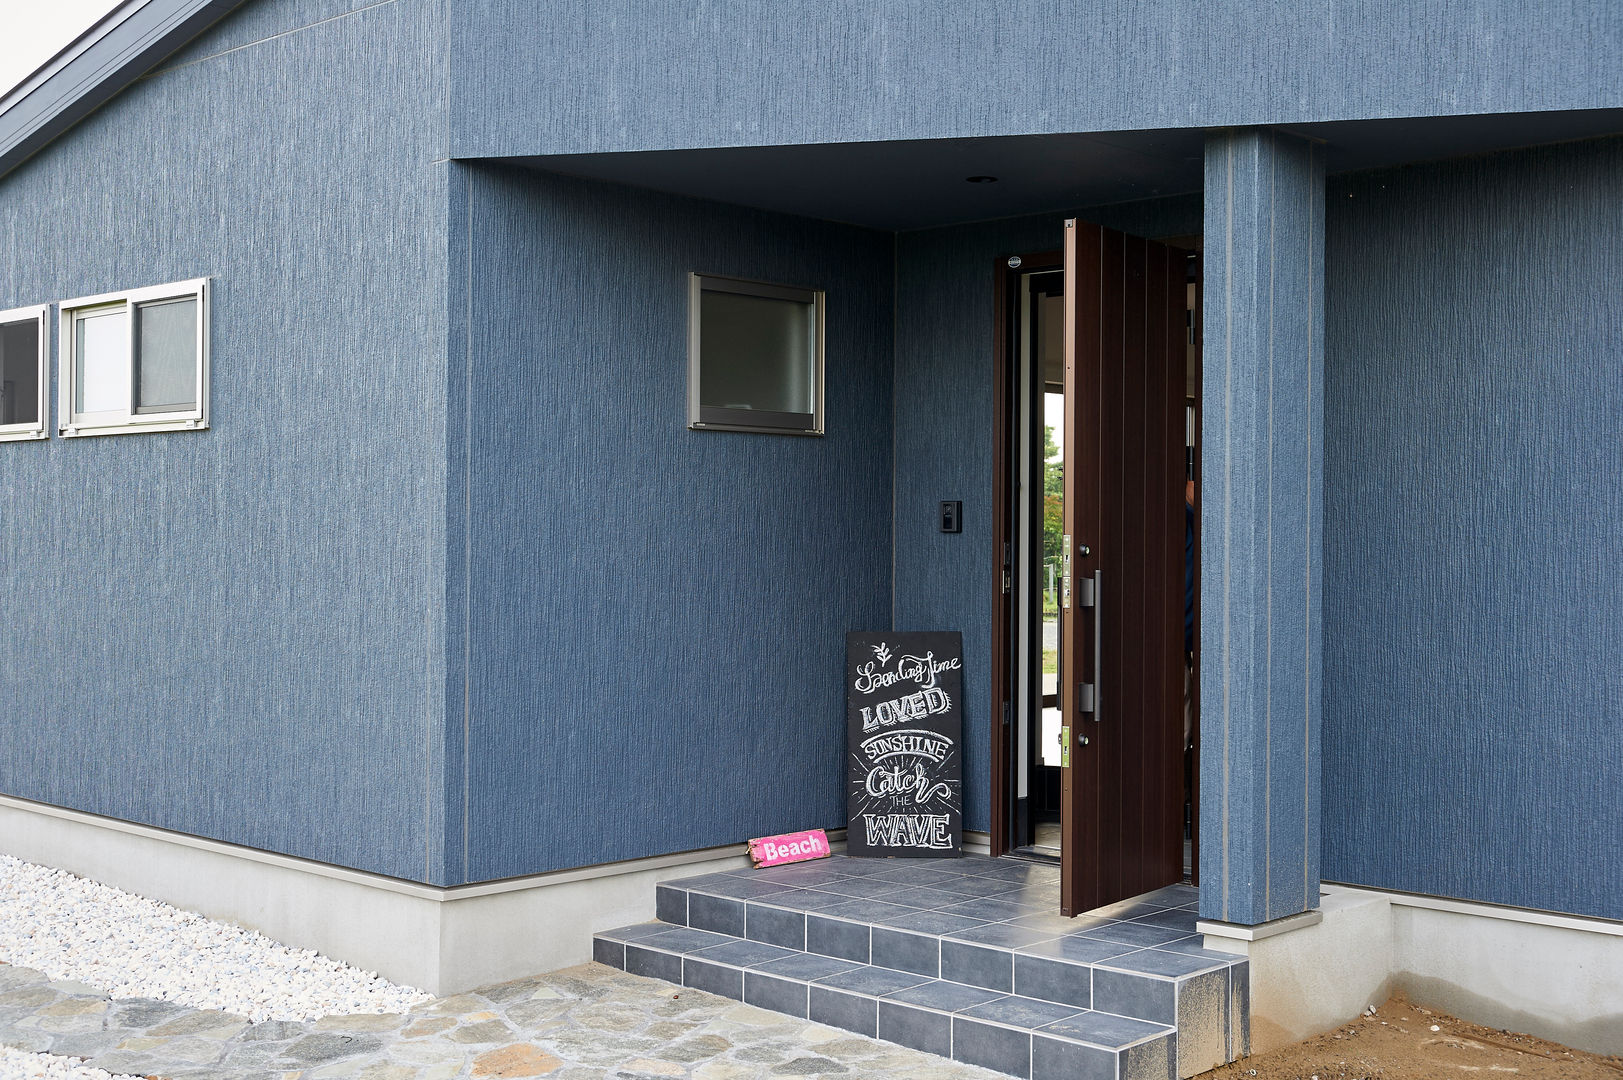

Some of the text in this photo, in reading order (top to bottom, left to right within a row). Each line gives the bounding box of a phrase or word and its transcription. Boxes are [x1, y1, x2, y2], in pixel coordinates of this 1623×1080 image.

[854, 650, 961, 694] Spending Time
[859, 687, 951, 732] LOVED
[864, 734, 950, 760] SUNSHINE
[865, 763, 952, 804] Catch
[889, 795, 912, 806] THE
[763, 835, 822, 861] Beach
[862, 813, 953, 849] WAVE
